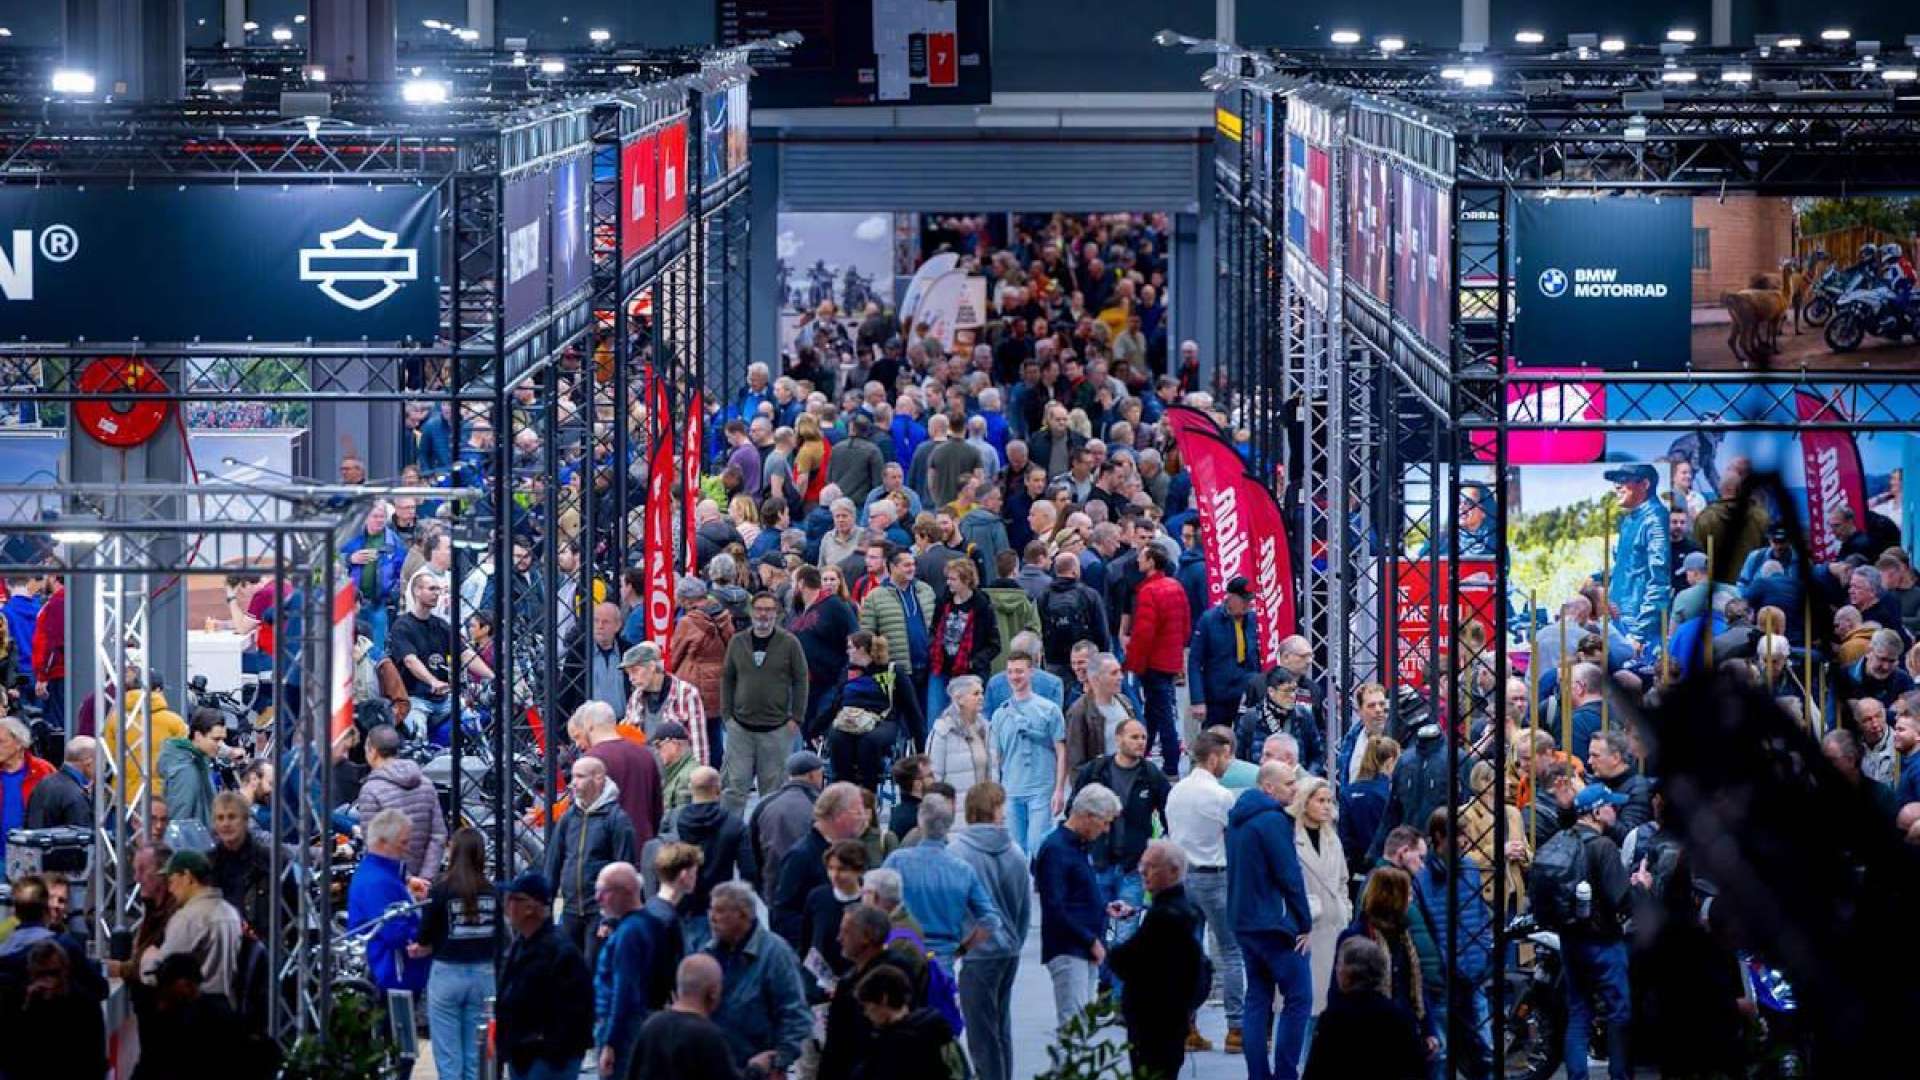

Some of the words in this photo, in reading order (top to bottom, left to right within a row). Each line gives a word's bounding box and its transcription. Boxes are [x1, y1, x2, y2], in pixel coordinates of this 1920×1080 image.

[936, 52, 948, 65] 7
[1574, 268, 1618, 282] BMW
[1574, 284, 1668, 298] MOTORRAD
